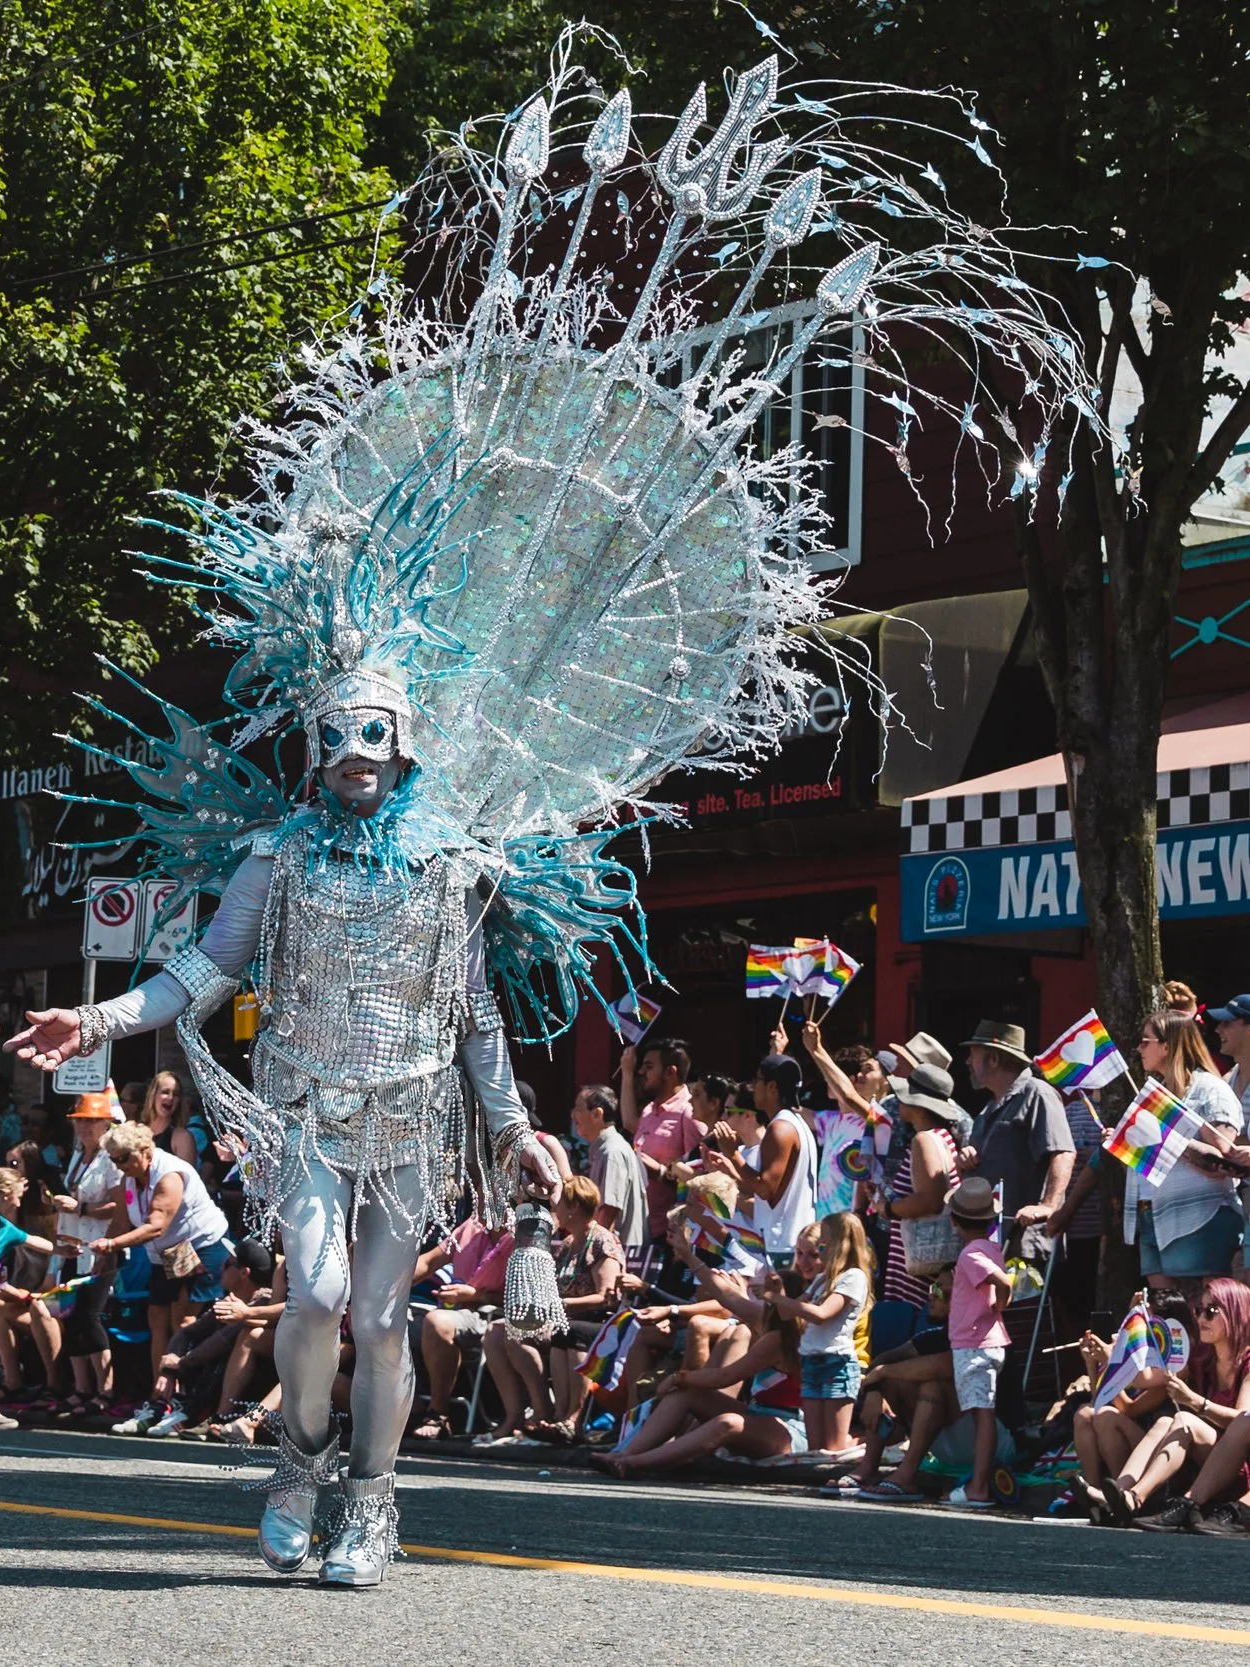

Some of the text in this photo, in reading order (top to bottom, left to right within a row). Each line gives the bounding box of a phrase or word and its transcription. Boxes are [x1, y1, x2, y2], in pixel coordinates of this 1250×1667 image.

[734, 787, 765, 809] Tea.
[769, 776, 842, 805] Licensed
[997, 851, 1082, 920] NAT
